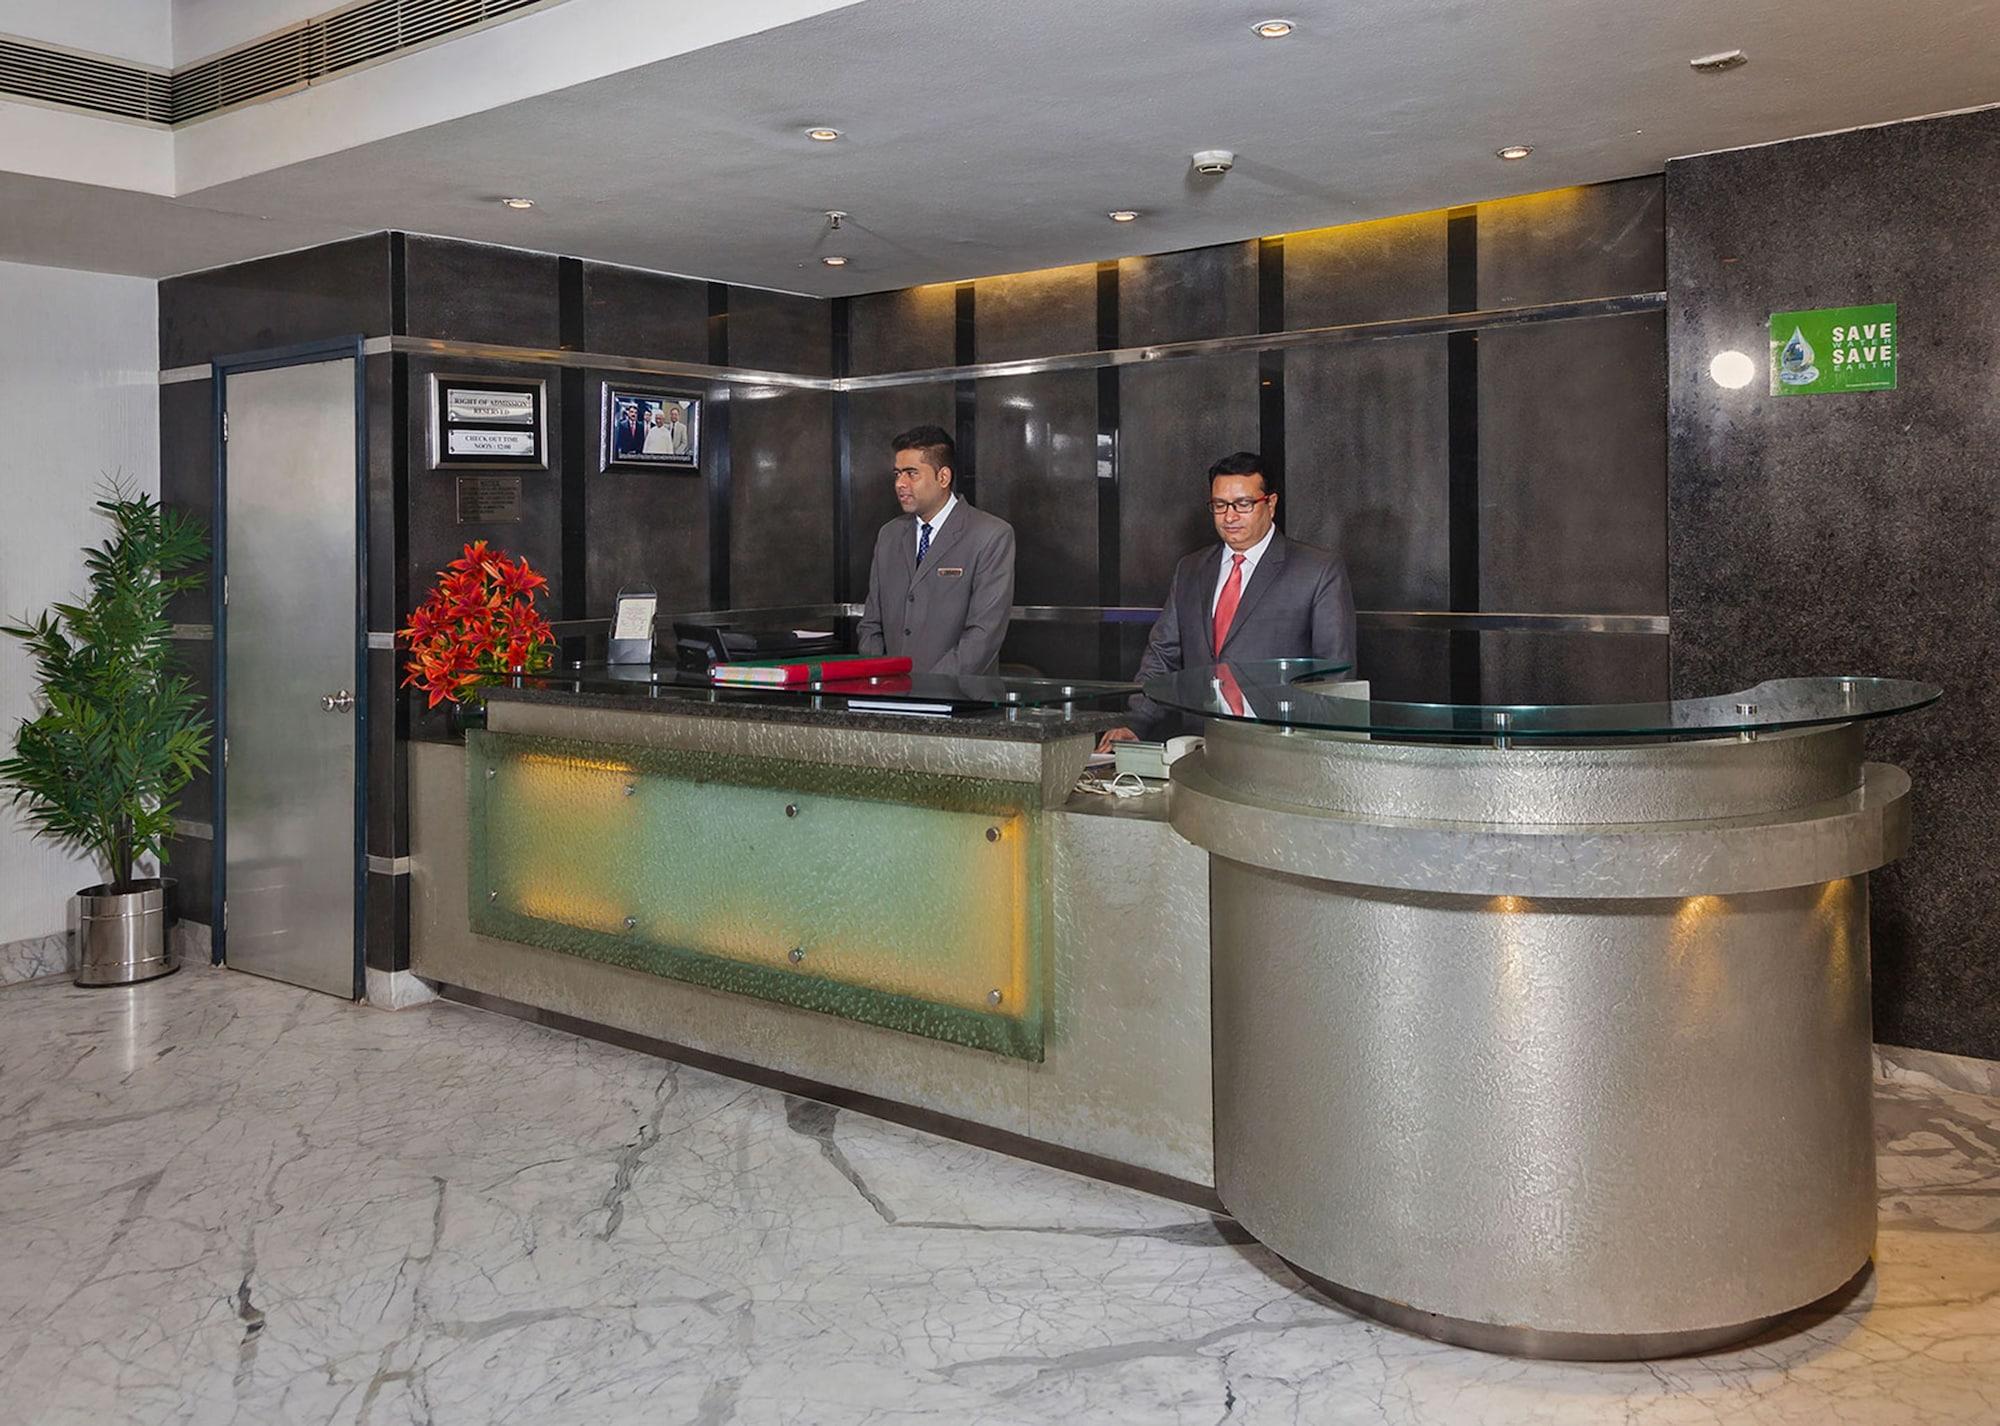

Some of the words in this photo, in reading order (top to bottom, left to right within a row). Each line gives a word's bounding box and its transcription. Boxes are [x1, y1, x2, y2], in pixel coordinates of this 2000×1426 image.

[1832, 323, 1892, 342] SAVE
[1832, 339, 1891, 348] WATER
[1832, 345, 1892, 364] SAVE
[1833, 361, 1891, 372] EARTH
